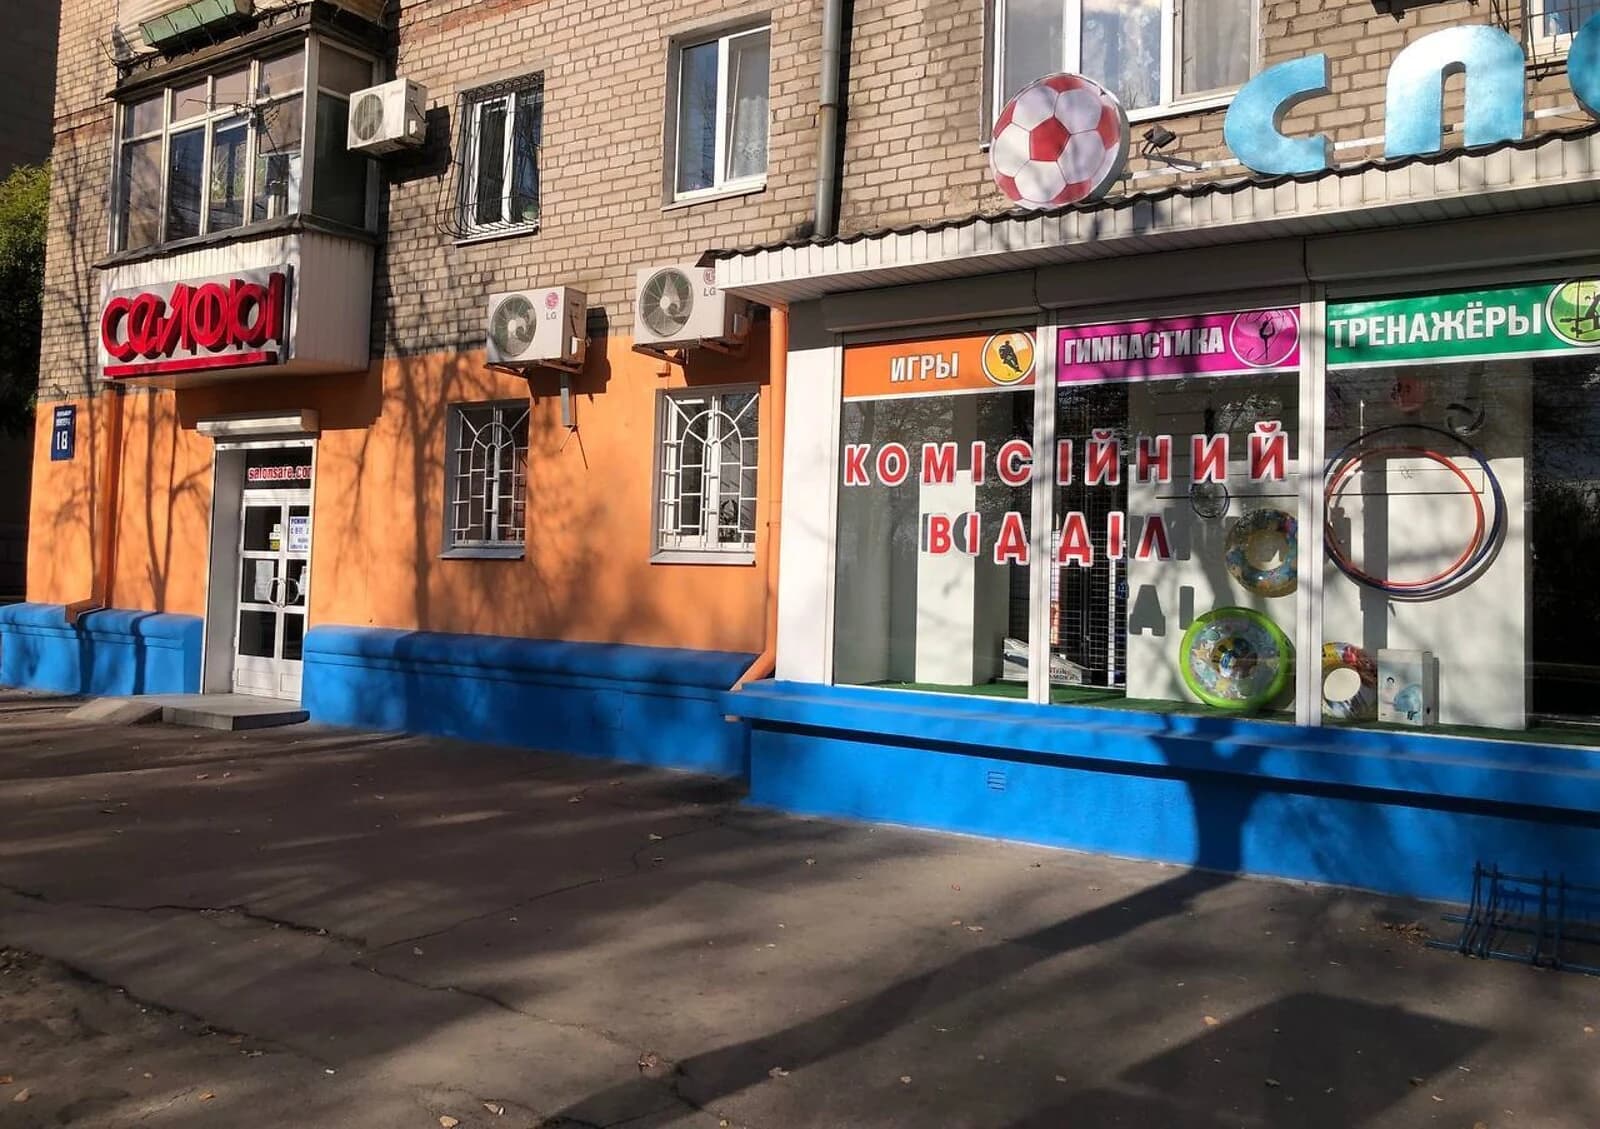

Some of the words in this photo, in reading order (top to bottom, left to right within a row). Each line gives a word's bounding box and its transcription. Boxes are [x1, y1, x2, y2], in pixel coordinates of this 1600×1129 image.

[703, 287, 716, 297] LG
[545, 311, 557, 321] LG
[1329, 302, 1541, 348] ТРЕНАЖЁРЫ
[1063, 327, 1225, 365] ГИМНАСТИКА
[890, 352, 959, 383] ИГРЫ
[56, 430, 68, 450] 18
[843, 421, 1289, 487] КОМІСІЙНИЙ
[926, 510, 1174, 567] ВІДДІЛ
